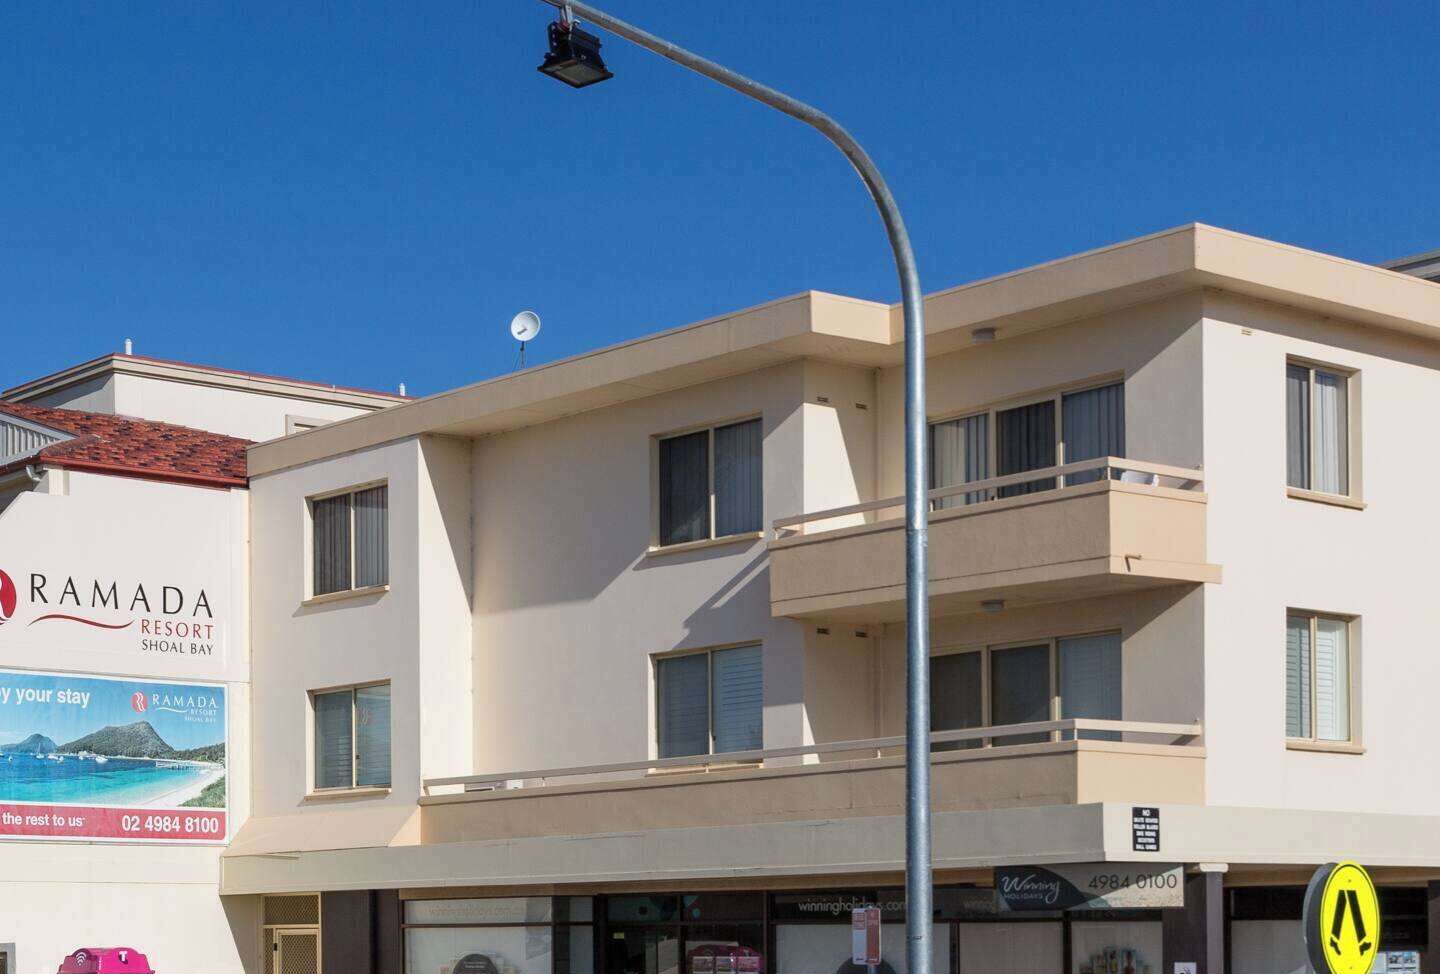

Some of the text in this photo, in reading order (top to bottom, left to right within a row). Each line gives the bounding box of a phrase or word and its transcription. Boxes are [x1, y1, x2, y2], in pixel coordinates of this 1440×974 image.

[30, 573, 213, 618] RAMADA
[141, 618, 214, 640] RESORT
[142, 638, 214, 655] SHOAL BAY
[15, 687, 53, 705] your
[57, 688, 91, 708] stay
[152, 693, 218, 709] RAMADA
[2, 812, 22, 825] the
[25, 815, 49, 826] rest
[52, 815, 65, 827] to
[68, 817, 82, 827] us
[121, 815, 218, 833] 02 4984 8100
[1001, 873, 1177, 904] Winning 4984 0100
[1004, 892, 1043, 900] HOLIDAYS
